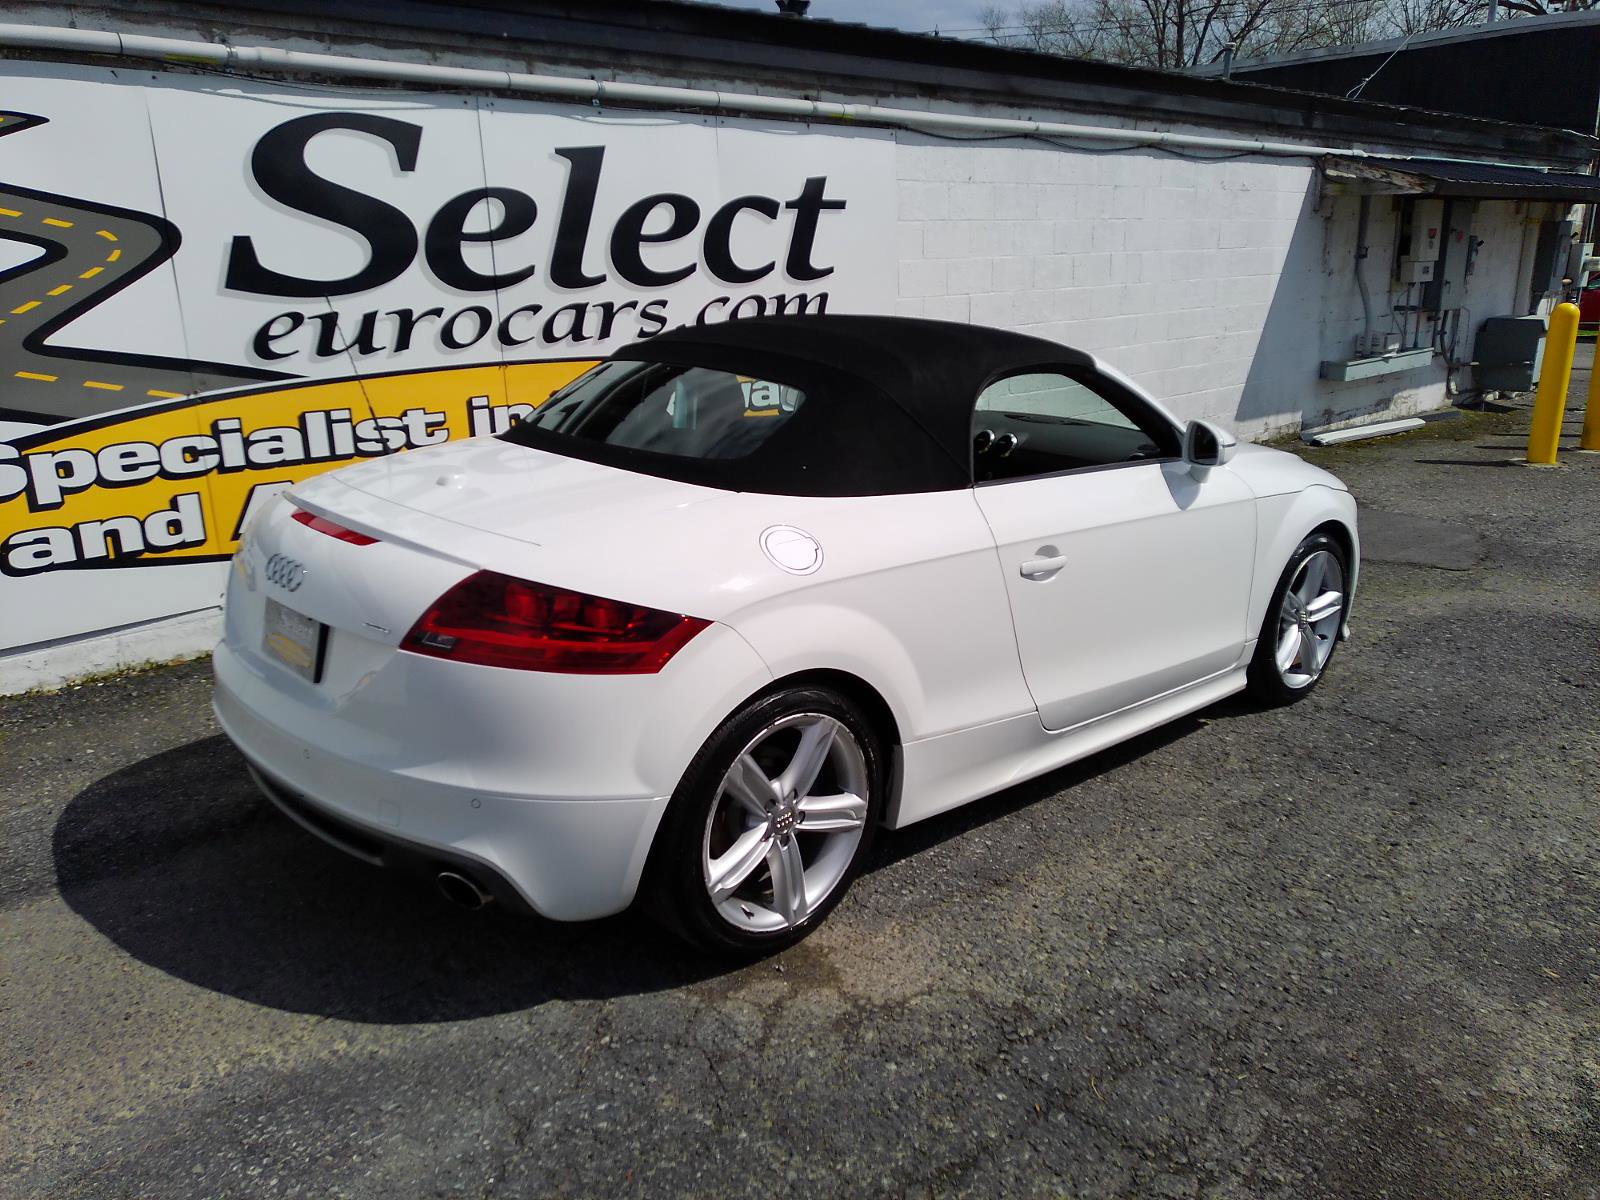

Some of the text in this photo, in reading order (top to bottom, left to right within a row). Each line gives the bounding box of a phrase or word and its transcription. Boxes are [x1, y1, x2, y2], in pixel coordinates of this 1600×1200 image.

[225, 112, 846, 298] Select
[252, 291, 829, 360] eurocarscom
[1, 492, 207, 573] and
